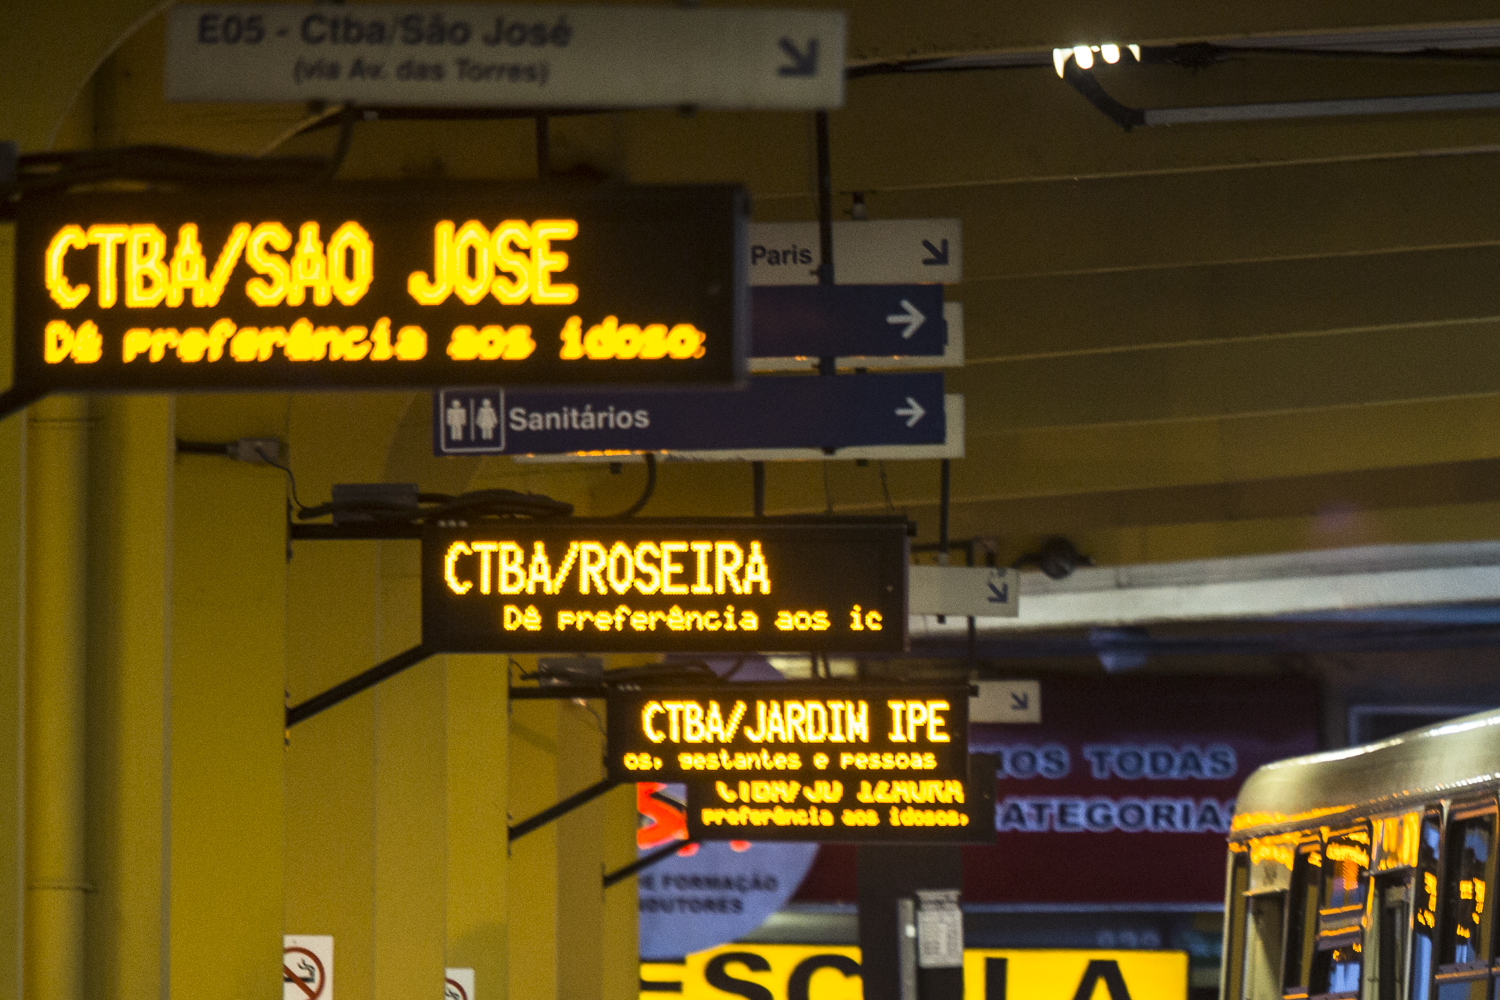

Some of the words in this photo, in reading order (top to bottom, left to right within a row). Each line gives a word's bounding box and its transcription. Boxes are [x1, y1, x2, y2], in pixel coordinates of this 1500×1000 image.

[198, 13, 266, 45] E05
[481, 15, 573, 48] José
[398, 60, 445, 82] das
[406, 219, 580, 306] JOSE
[750, 244, 813, 267] Paris
[121, 316, 428, 364] preferência
[445, 324, 538, 362] aos
[508, 402, 651, 433] Sanitários
[443, 539, 772, 597] CTBA/ROSEIRA
[502, 603, 543, 632] Dê
[556, 603, 760, 633] preferência
[773, 609, 831, 632] aos
[886, 699, 952, 745] IPE
[676, 748, 803, 772] gestantes
[813, 752, 831, 771] e
[838, 752, 938, 772] pessoas
[1086, 745, 1236, 779] TODAS
[701, 804, 835, 829] preferência
[840, 808, 882, 828] aos
[997, 797, 1232, 833] ATEGORIA
